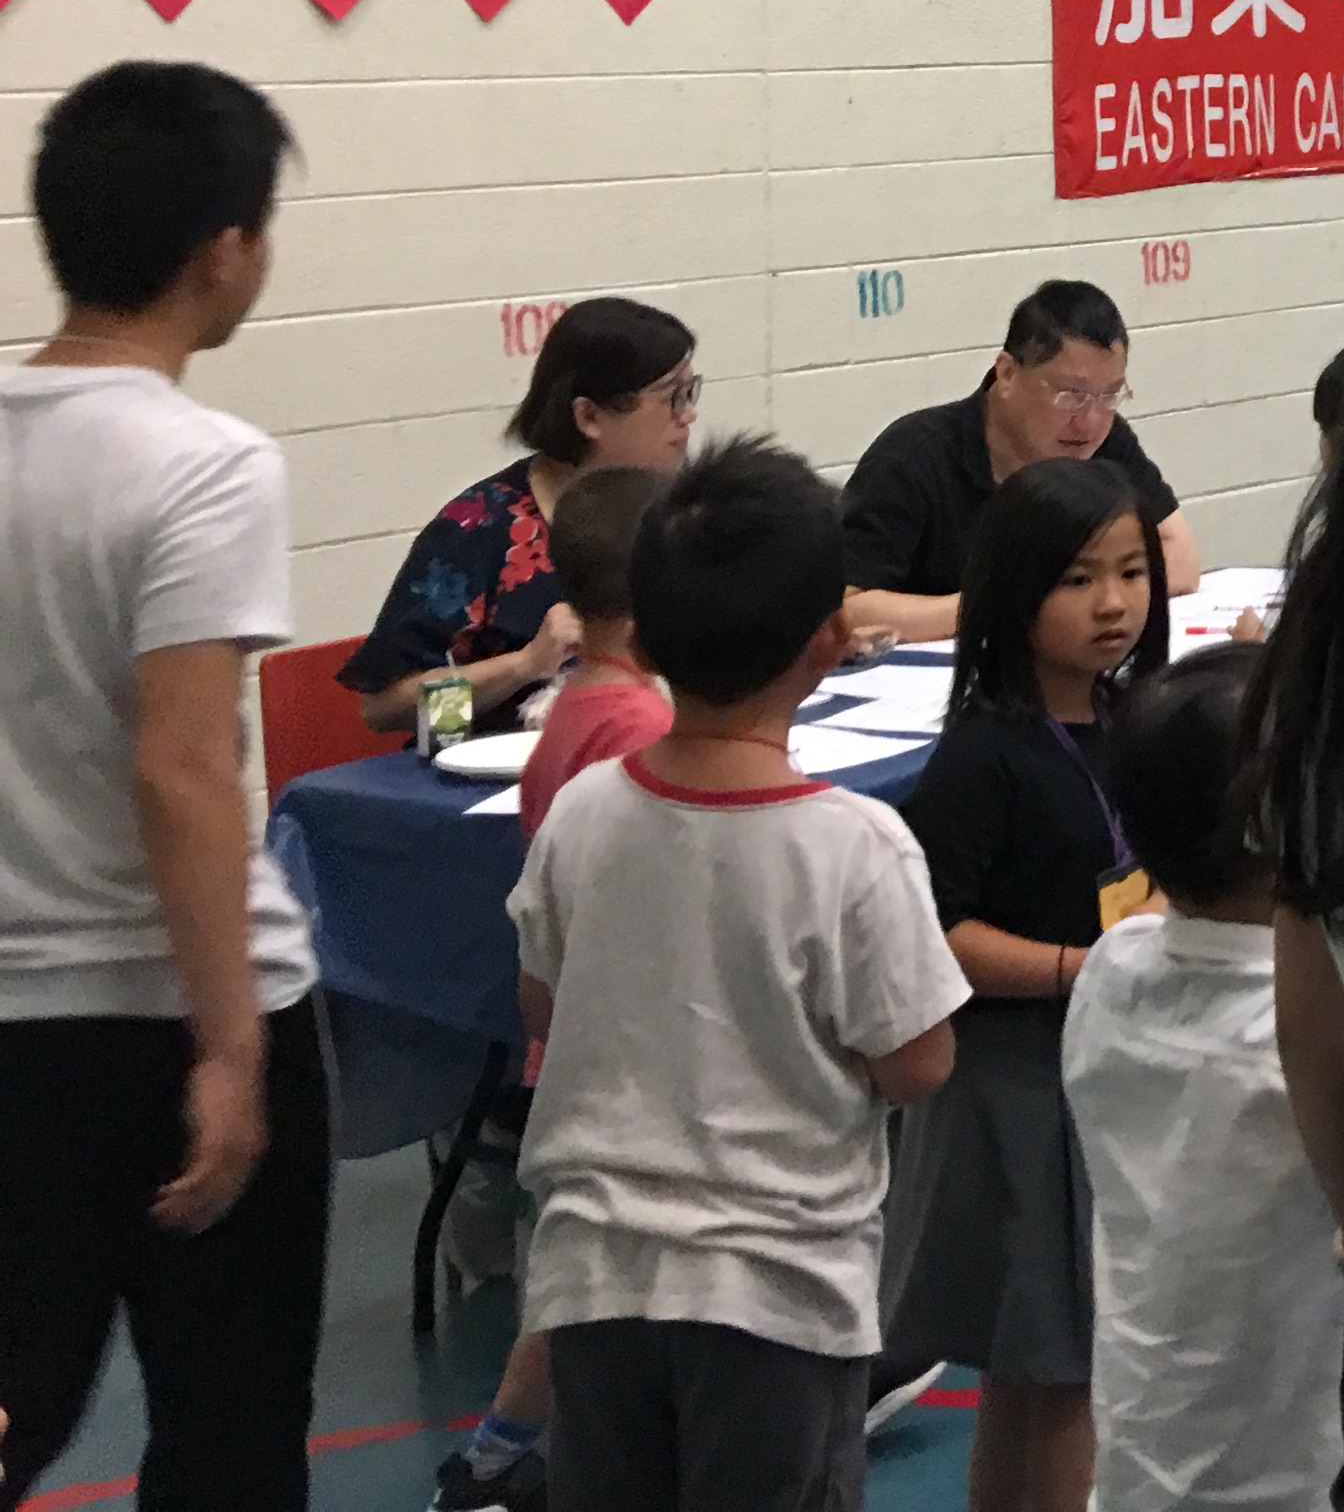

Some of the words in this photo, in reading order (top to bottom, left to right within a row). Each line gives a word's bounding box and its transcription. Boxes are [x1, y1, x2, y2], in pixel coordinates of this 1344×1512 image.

[1095, 74, 1276, 170] EASTERN
[1141, 240, 1191, 285] 109
[857, 268, 905, 318] 110
